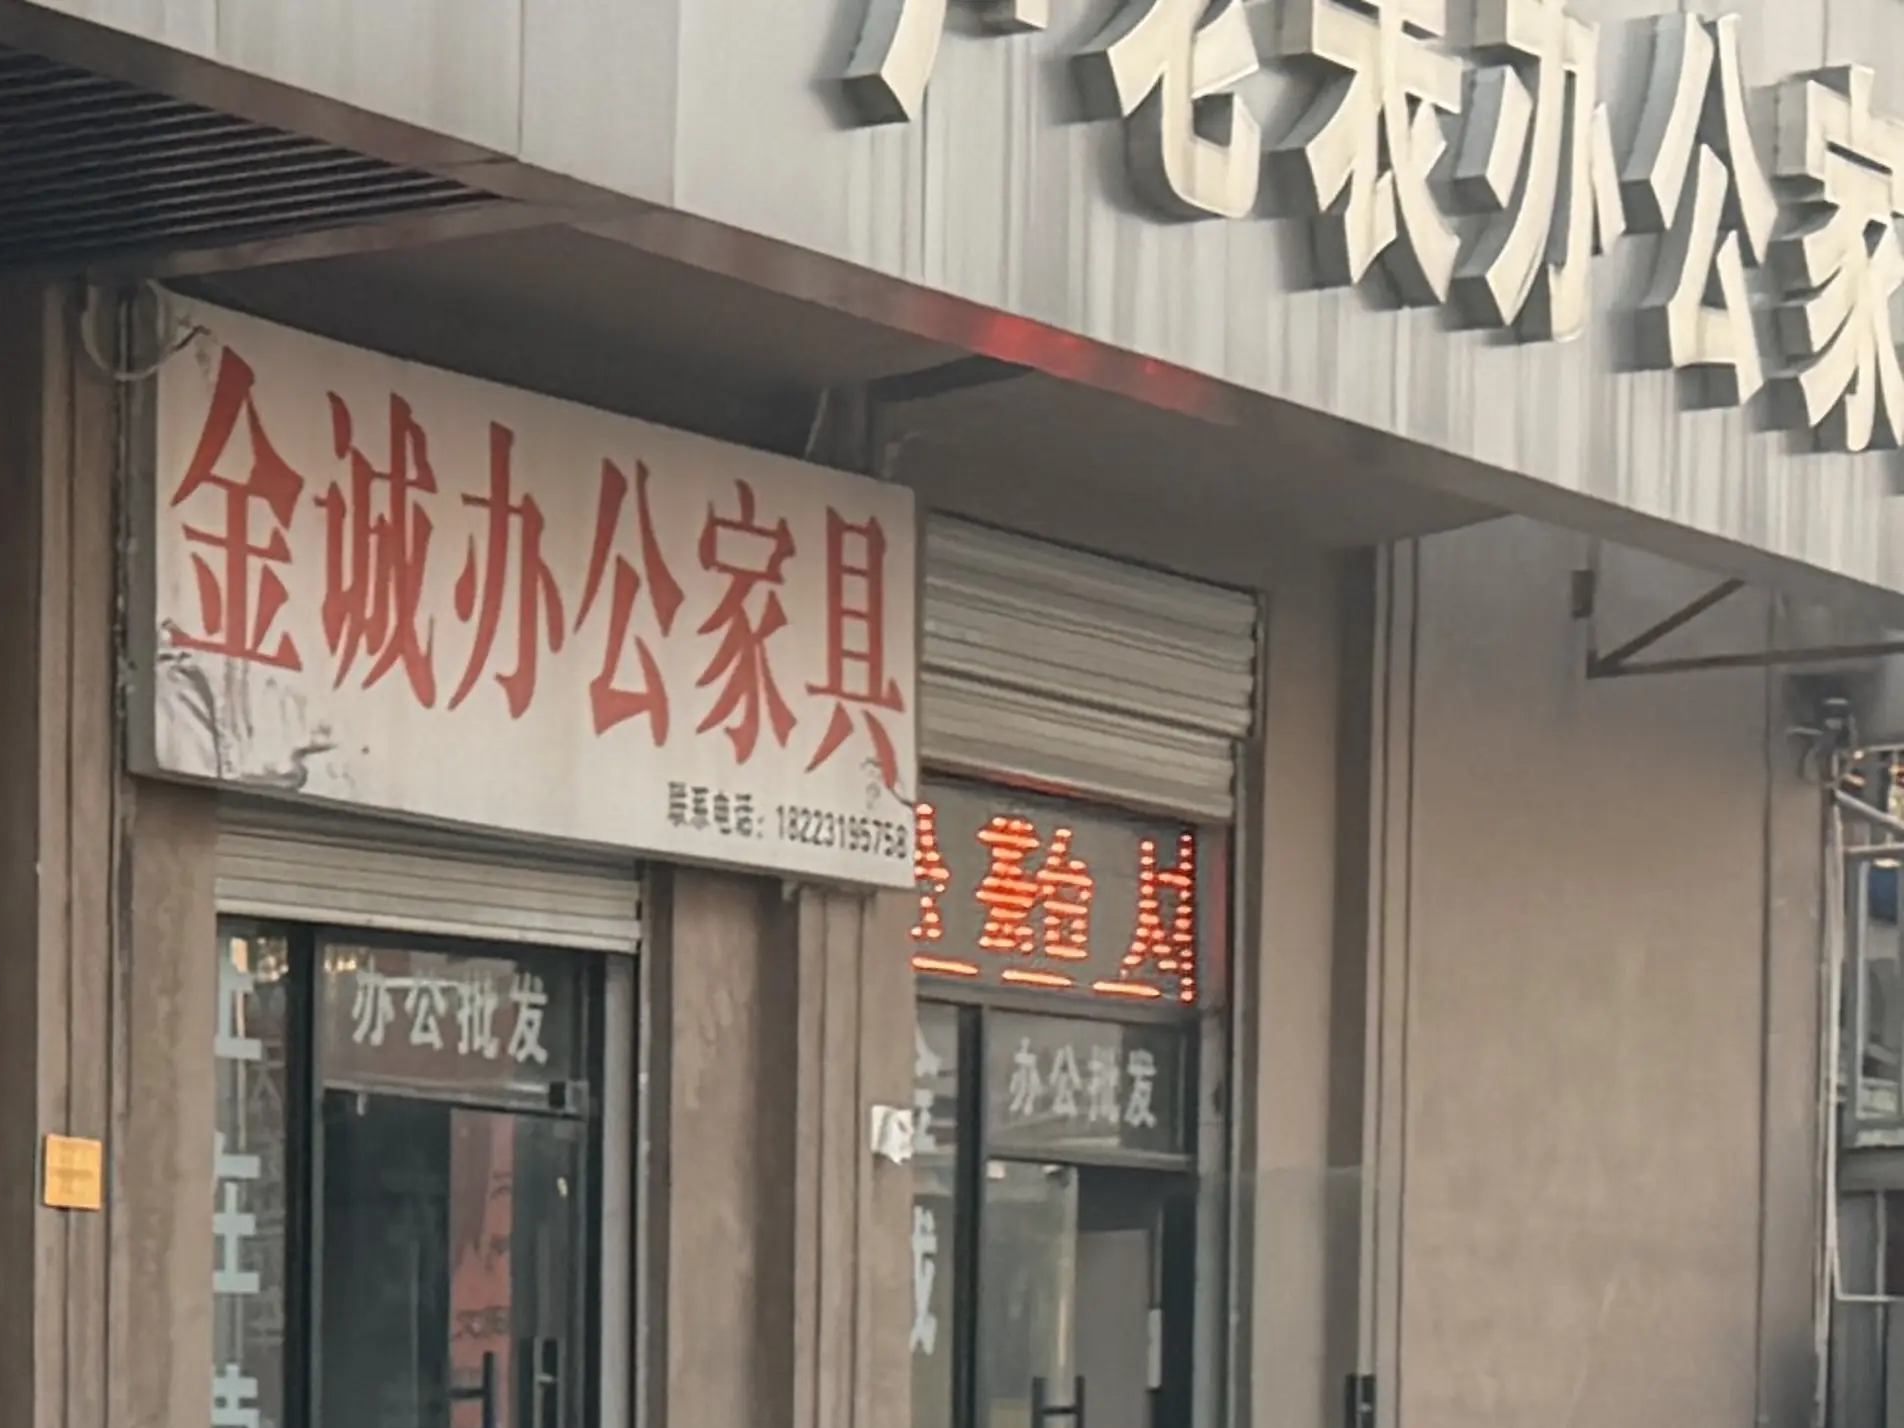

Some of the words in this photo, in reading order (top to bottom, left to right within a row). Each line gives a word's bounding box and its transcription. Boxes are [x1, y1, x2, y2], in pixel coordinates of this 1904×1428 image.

[170, 344, 904, 788] 金诚办公家具
